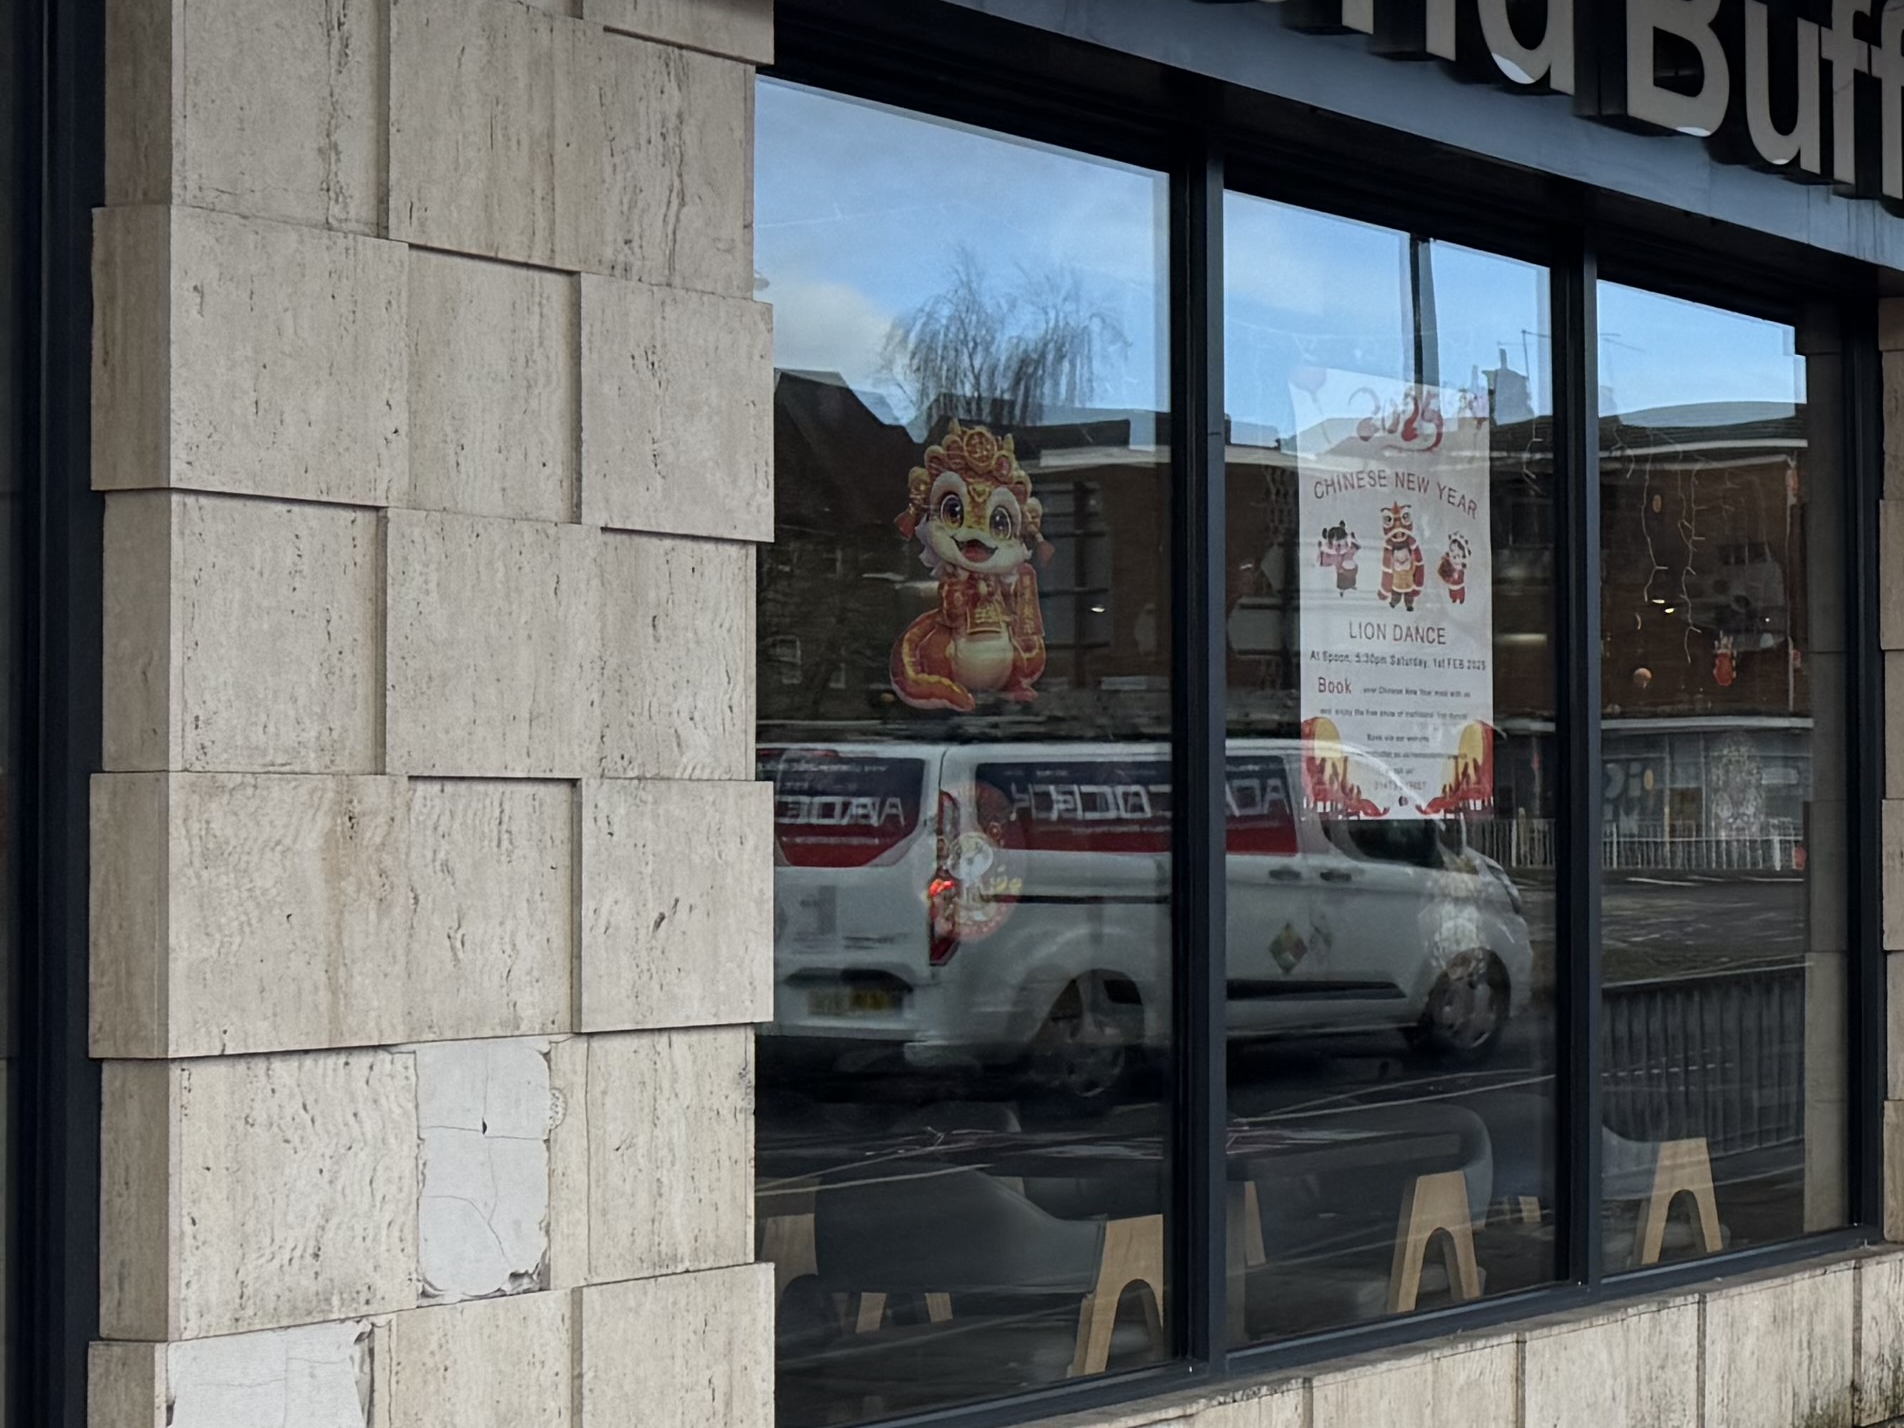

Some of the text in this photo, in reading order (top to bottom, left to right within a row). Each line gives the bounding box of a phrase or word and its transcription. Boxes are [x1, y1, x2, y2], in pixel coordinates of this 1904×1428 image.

[1313, 469, 1478, 520] CHINESE NEW YEAR
[1349, 619, 1447, 645] LION DANCE
[1447, 658, 1465, 670] FEB
[1317, 676, 1353, 695] Book
